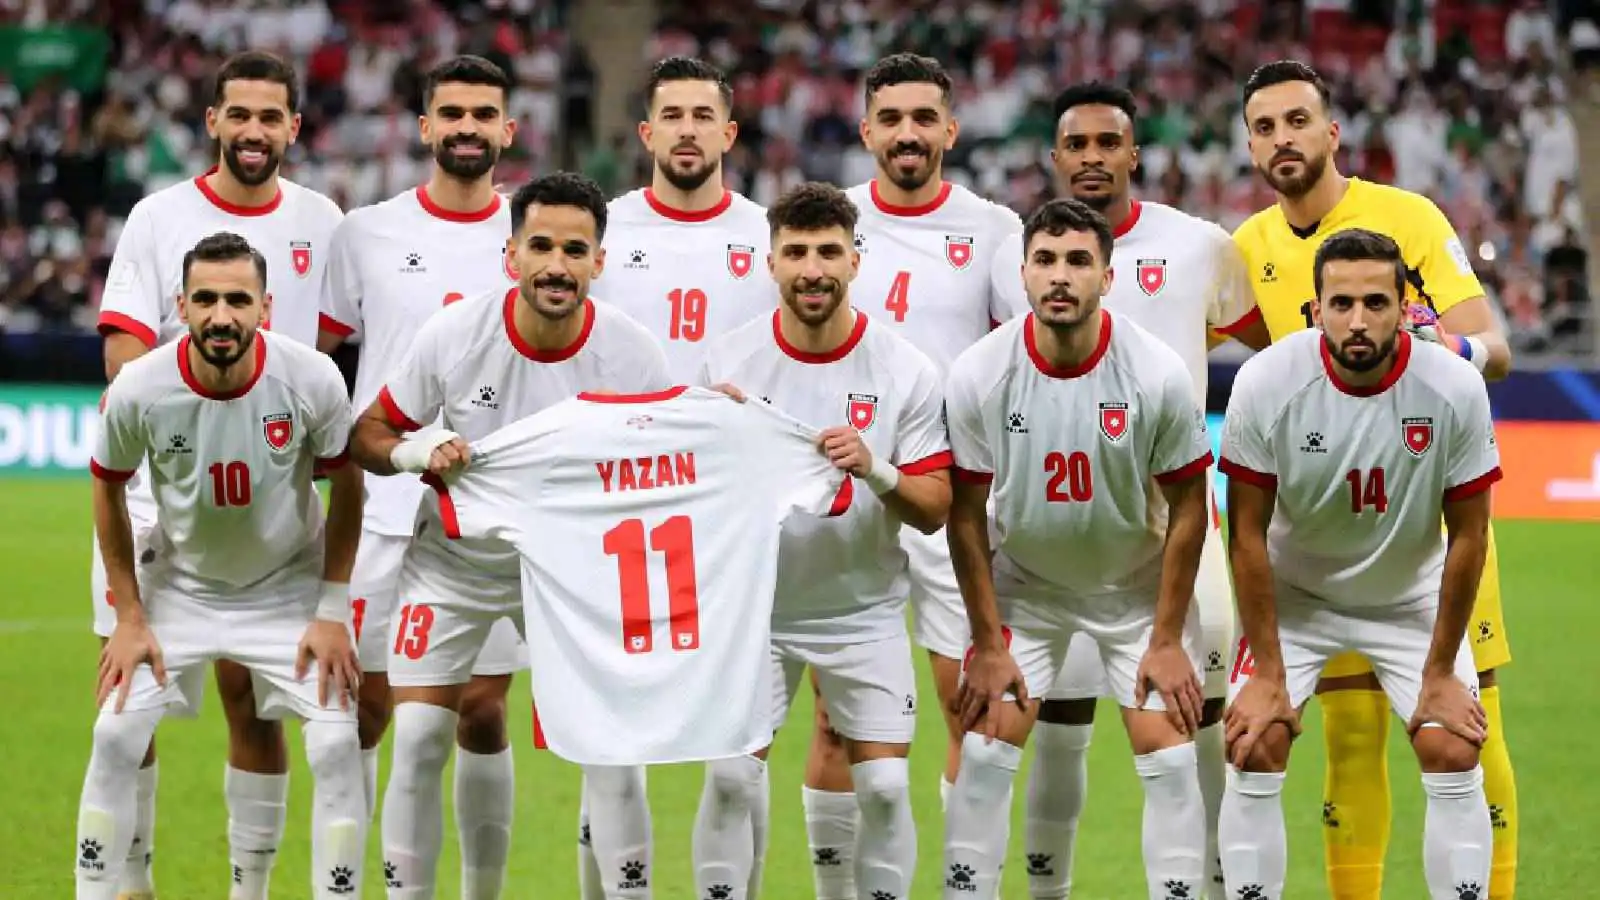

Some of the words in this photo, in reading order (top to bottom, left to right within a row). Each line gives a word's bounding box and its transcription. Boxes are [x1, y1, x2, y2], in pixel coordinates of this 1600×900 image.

[667, 288, 708, 342] 19
[884, 271, 911, 322] 4
[209, 460, 251, 506] 10
[595, 452, 696, 492] YAZAN
[1044, 451, 1092, 502] 20
[1346, 467, 1388, 513] 14
[603, 515, 699, 653] 11
[394, 604, 434, 660] 13
